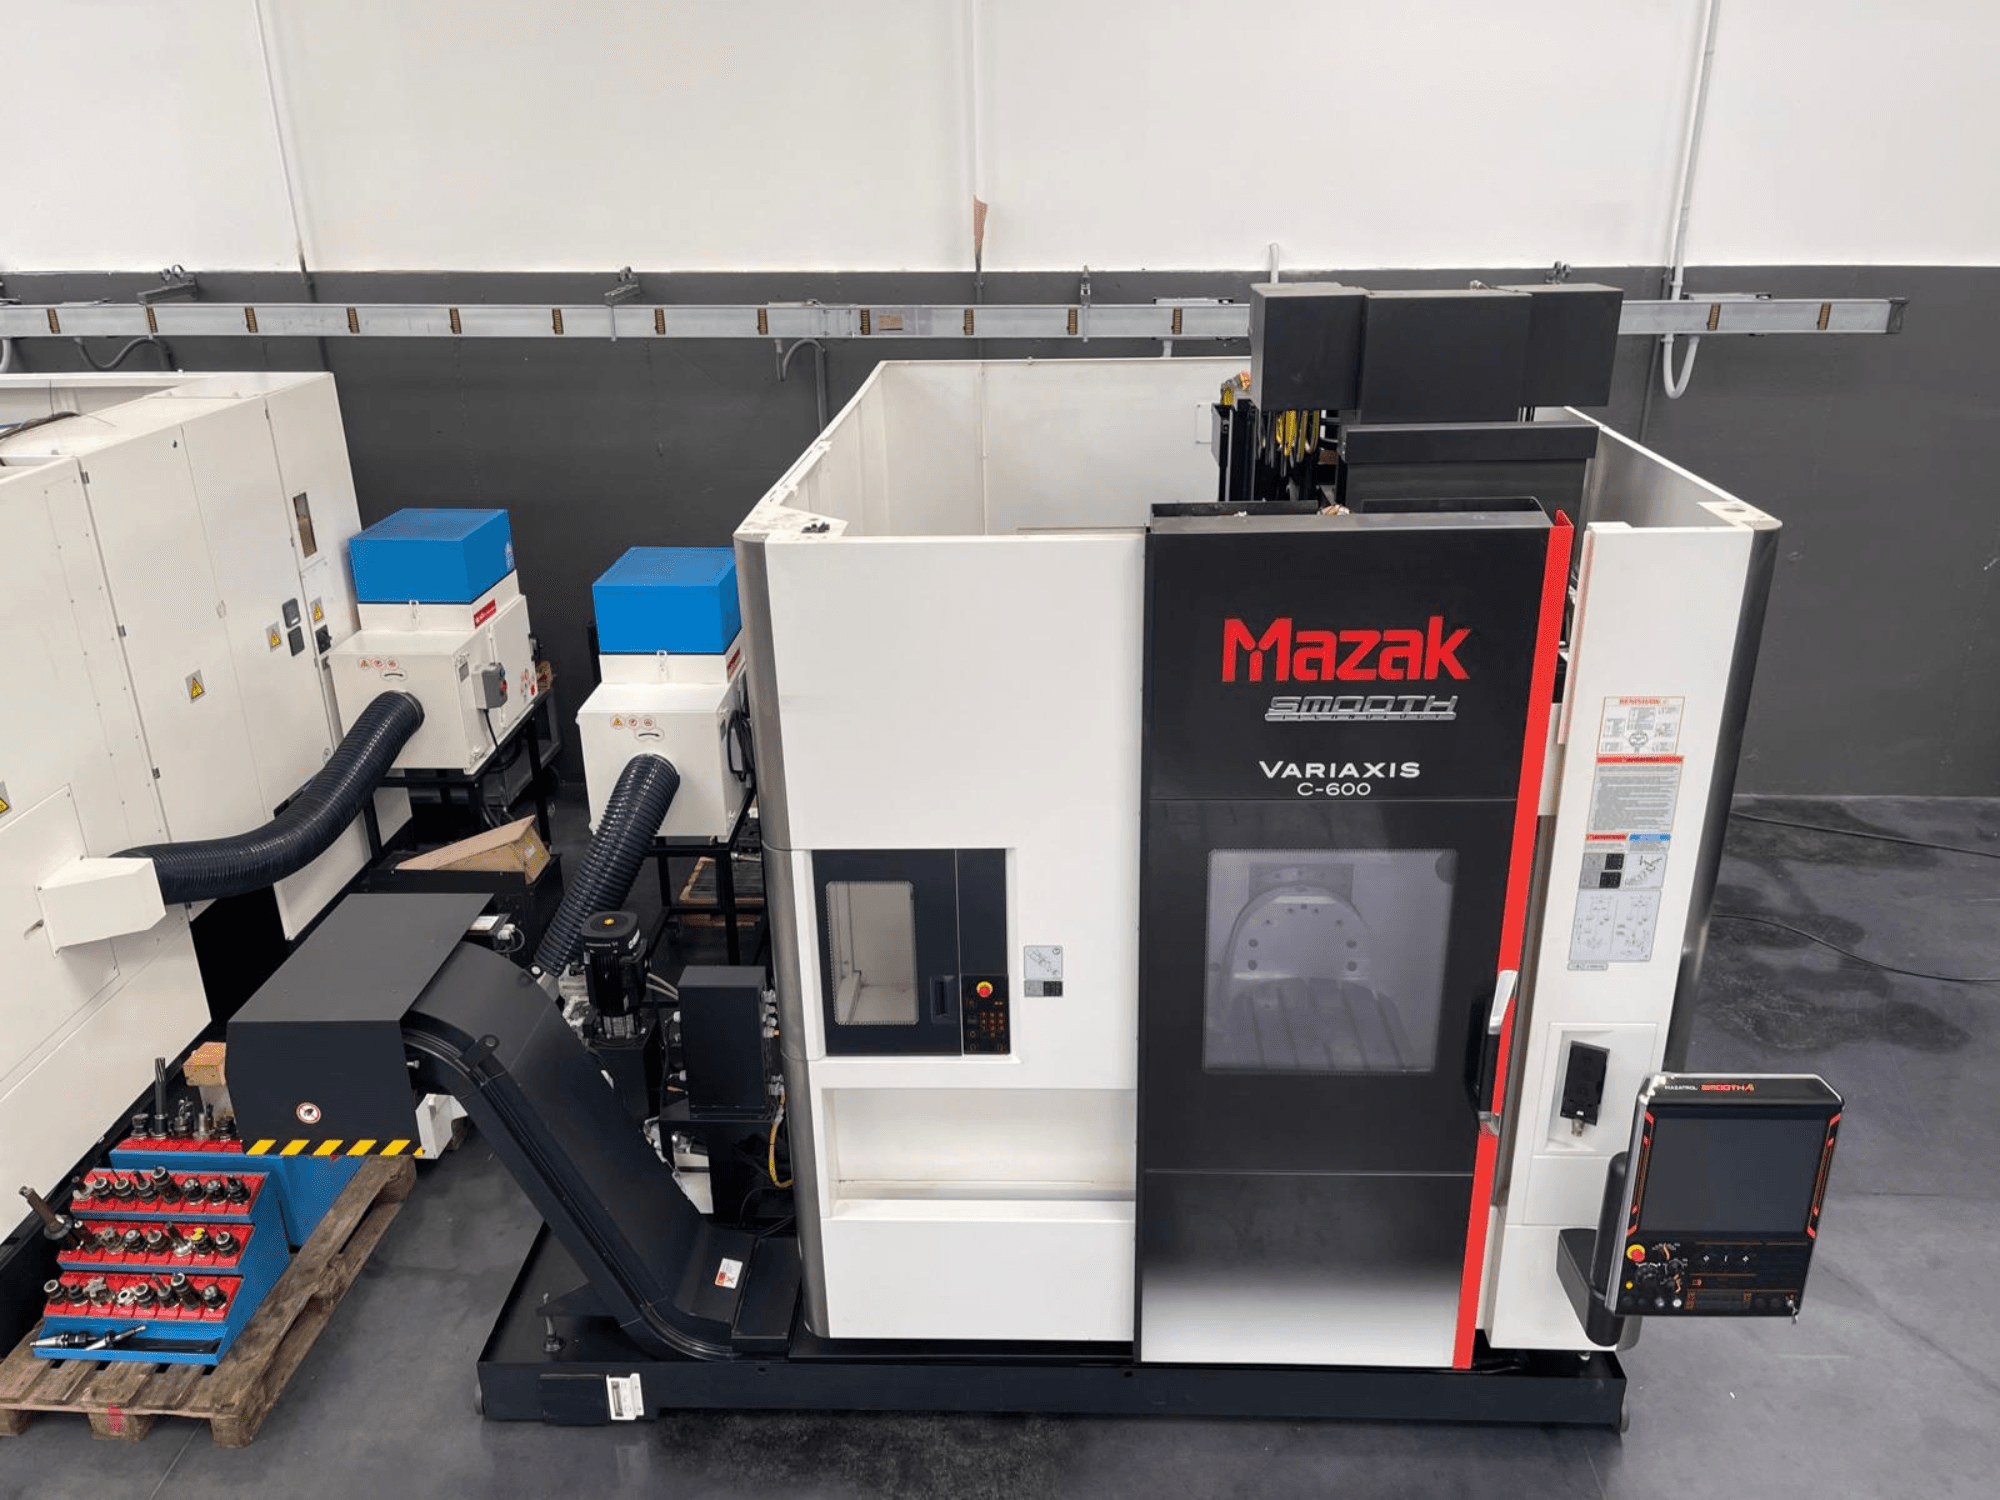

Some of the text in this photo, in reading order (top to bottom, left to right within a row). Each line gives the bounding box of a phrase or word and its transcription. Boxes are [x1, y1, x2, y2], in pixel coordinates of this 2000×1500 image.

[1222, 615, 1471, 682] Mazak
[1268, 695, 1459, 714] SMOOTH
[1259, 760, 1421, 779] VARIAXIS
[1297, 782, 1371, 796] C-600
